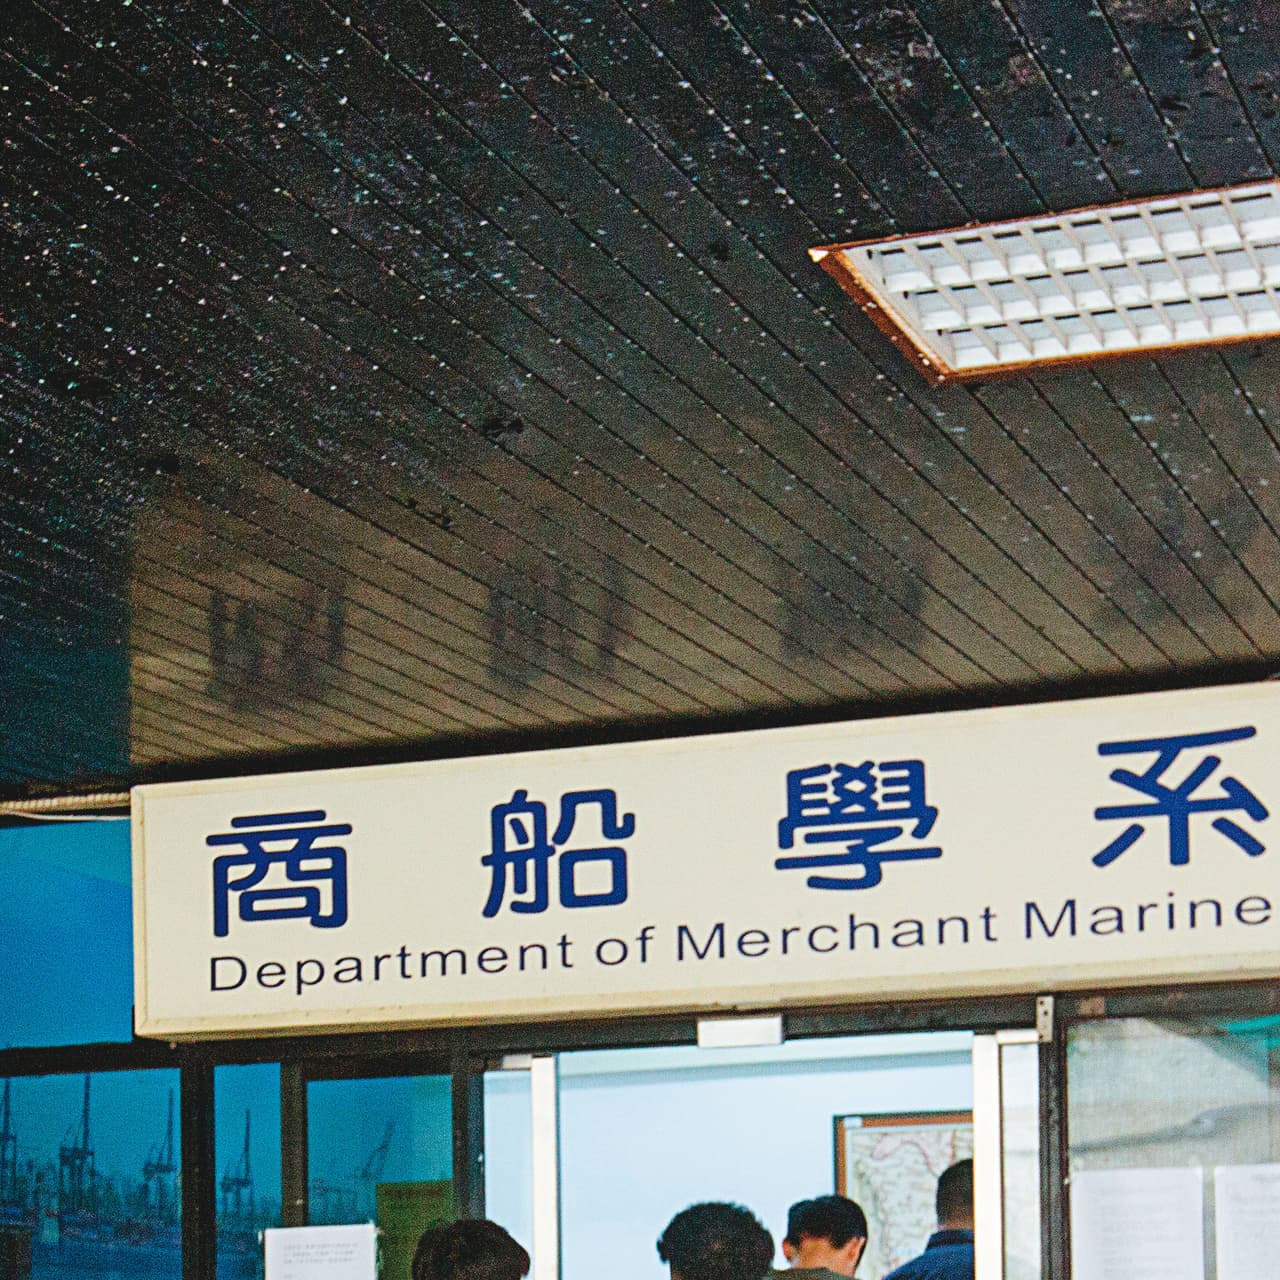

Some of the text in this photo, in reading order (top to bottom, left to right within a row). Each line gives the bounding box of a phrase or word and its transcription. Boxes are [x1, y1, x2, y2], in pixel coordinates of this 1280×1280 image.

[206, 726, 1270, 938] 商船學系
[210, 890, 1272, 996] Department of Merchant Marine
